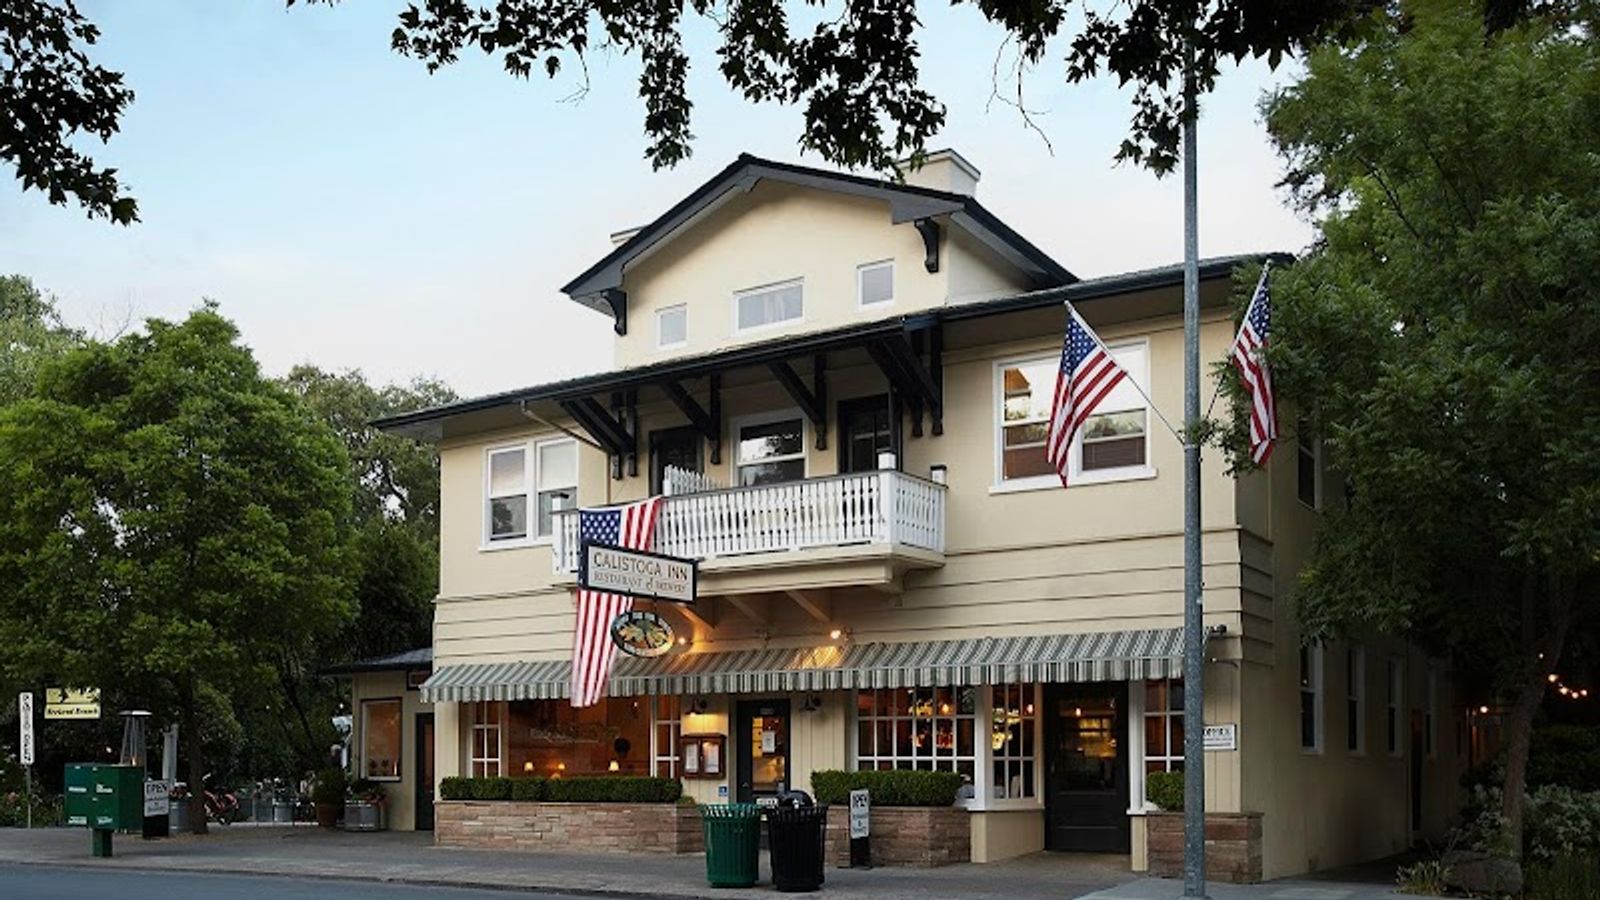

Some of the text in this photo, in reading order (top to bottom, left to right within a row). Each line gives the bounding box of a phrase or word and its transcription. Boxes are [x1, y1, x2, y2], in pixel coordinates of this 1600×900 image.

[594, 552, 688, 581] CALISTOGA INN
[594, 571, 686, 593] RESTAURANT & BREWERY
[146, 783, 167, 794] OPEN
